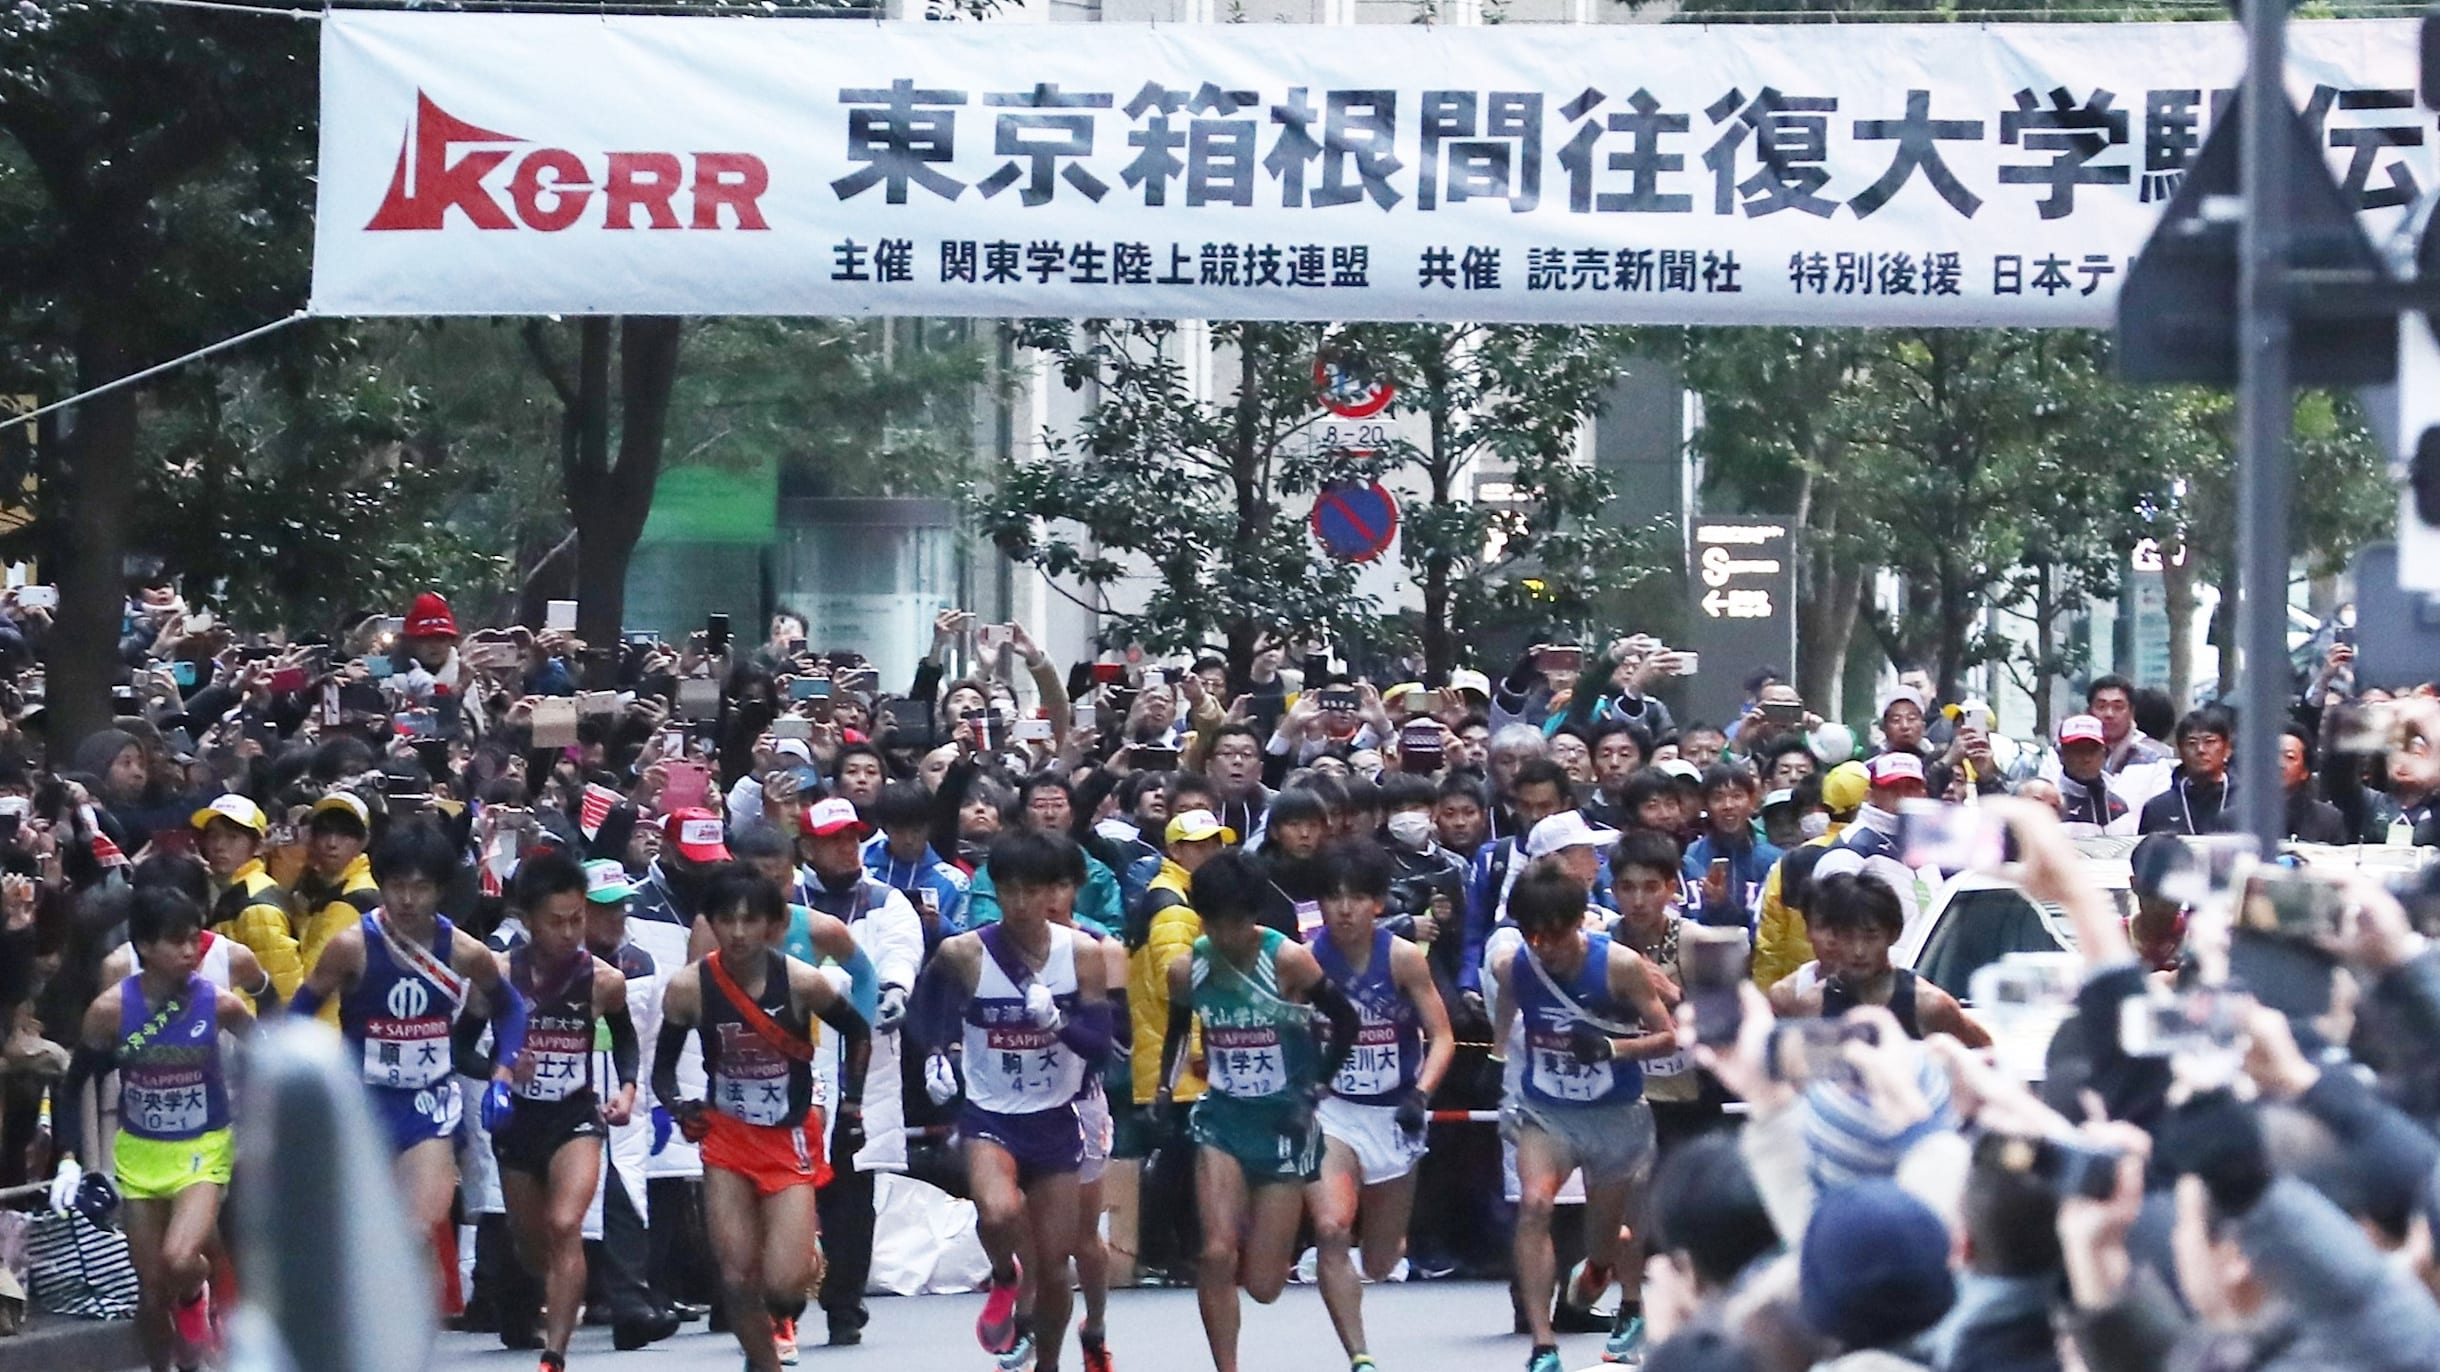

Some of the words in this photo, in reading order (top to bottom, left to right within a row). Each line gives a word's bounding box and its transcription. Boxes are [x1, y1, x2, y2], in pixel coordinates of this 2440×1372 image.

[831, 237, 914, 283] 主催
[940, 239, 1369, 287] 関東学生陸上競技連盟
[1418, 245, 1501, 291] 共催
[1527, 247, 1742, 293] 読売新聞社
[1789, 250, 1962, 296] 特別後援
[1993, 253, 2135, 296] 日本テ
[385, 1021, 448, 1037] SAPPORO
[537, 1054, 577, 1079] 士大
[1012, 1077, 1052, 1092] 4-1
